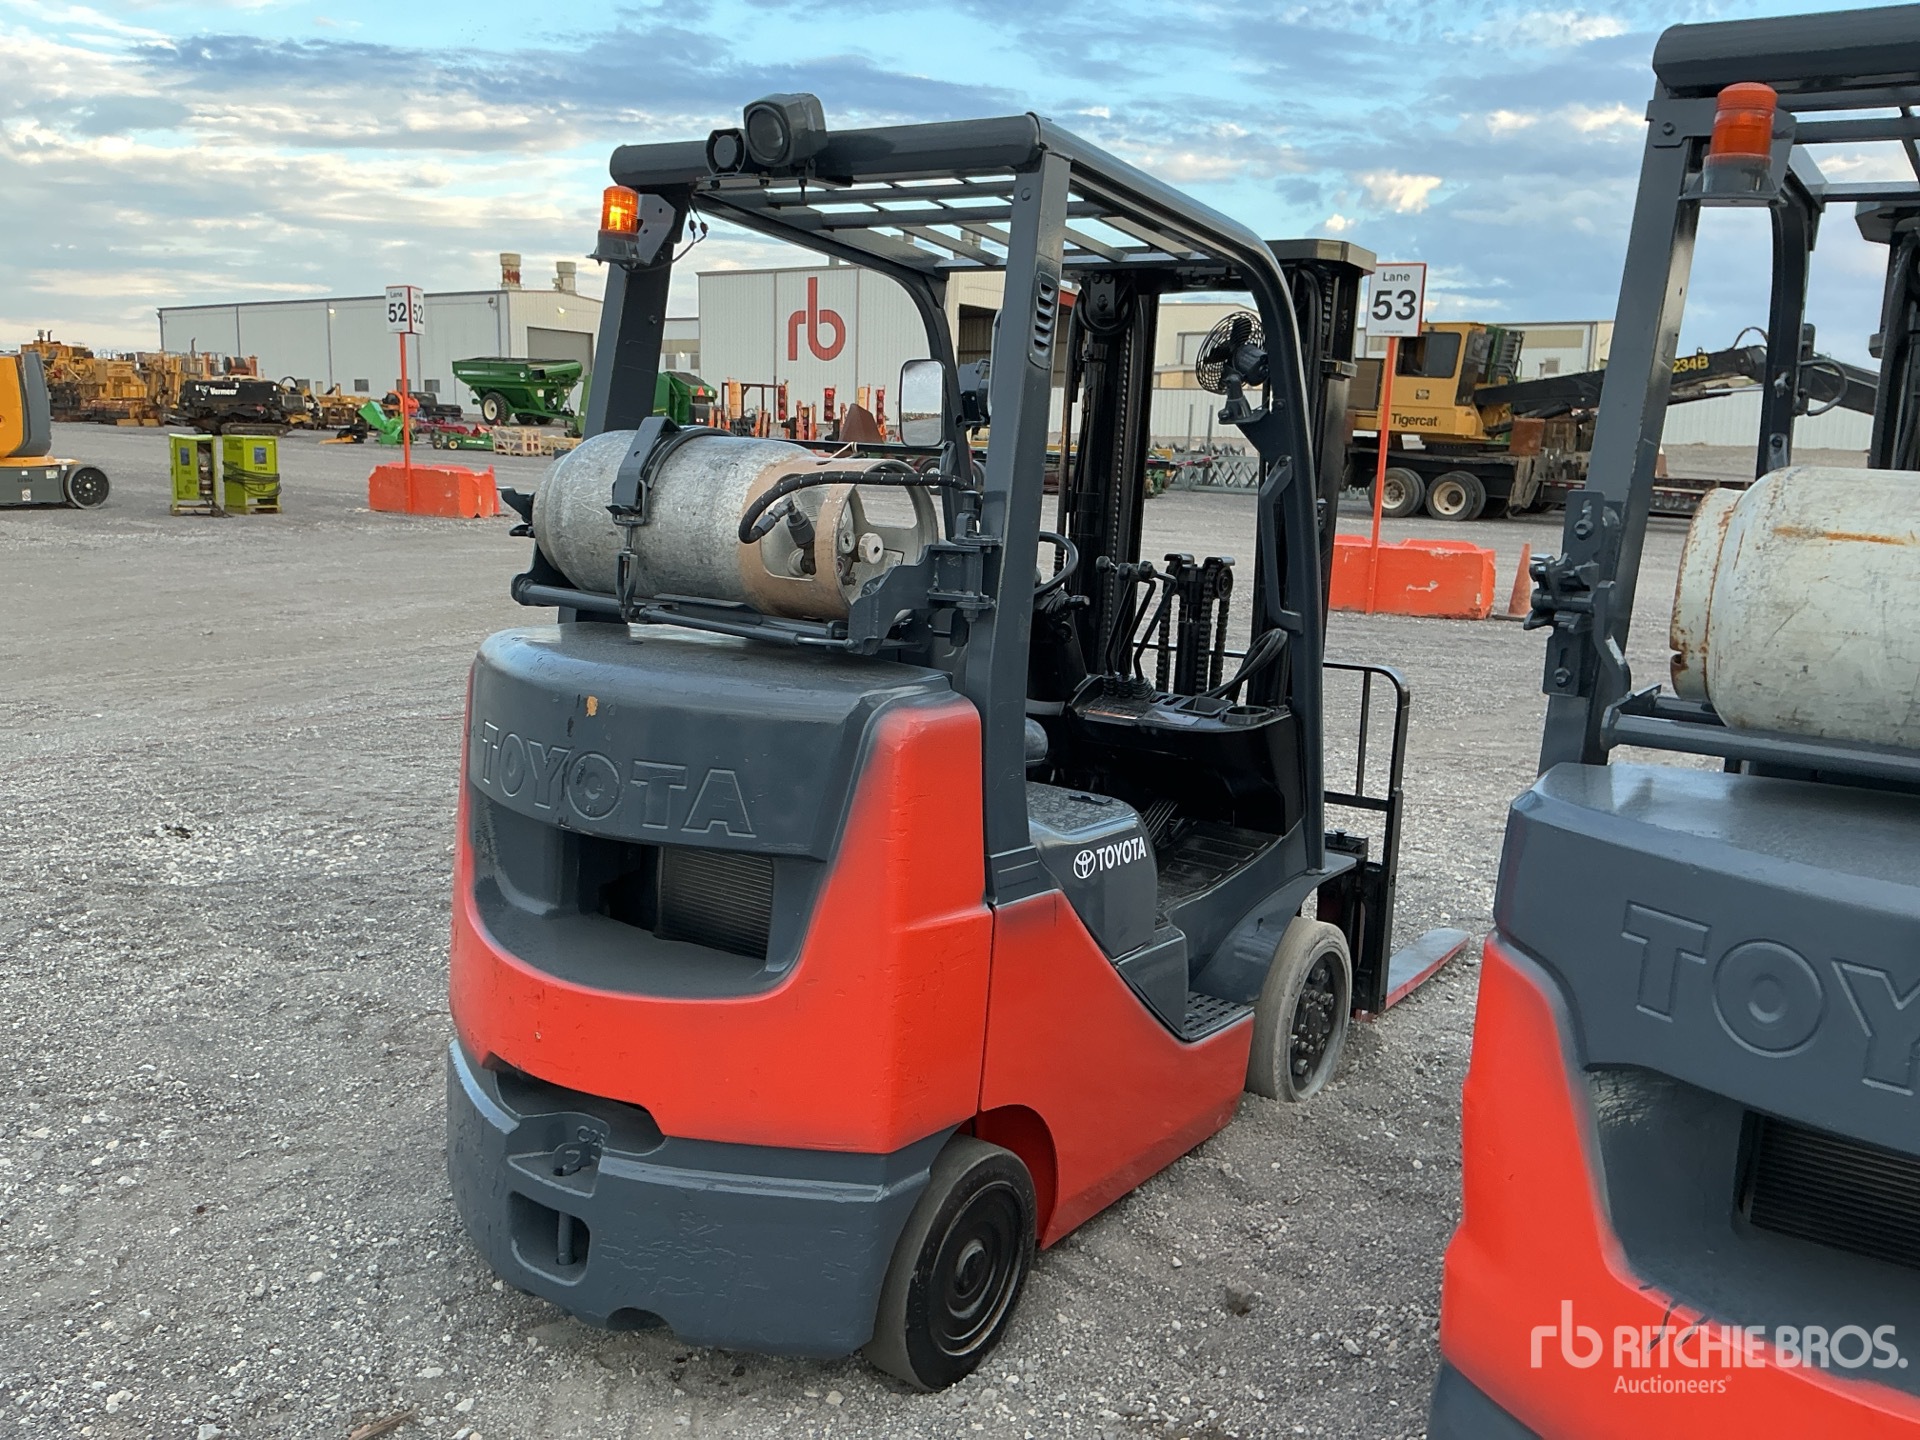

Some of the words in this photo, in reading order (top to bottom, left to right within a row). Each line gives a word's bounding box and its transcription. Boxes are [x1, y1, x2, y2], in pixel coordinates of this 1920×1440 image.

[1382, 272, 1411, 282] Lane
[388, 302, 408, 323] 52
[412, 303, 424, 325] 52
[1372, 289, 1416, 321] 53
[787, 276, 846, 361] rb
[1672, 355, 1710, 374] 234B
[1391, 412, 1439, 428] Tigercat
[482, 718, 757, 838] TOYOTA
[1096, 836, 1147, 871] TOYOTA
